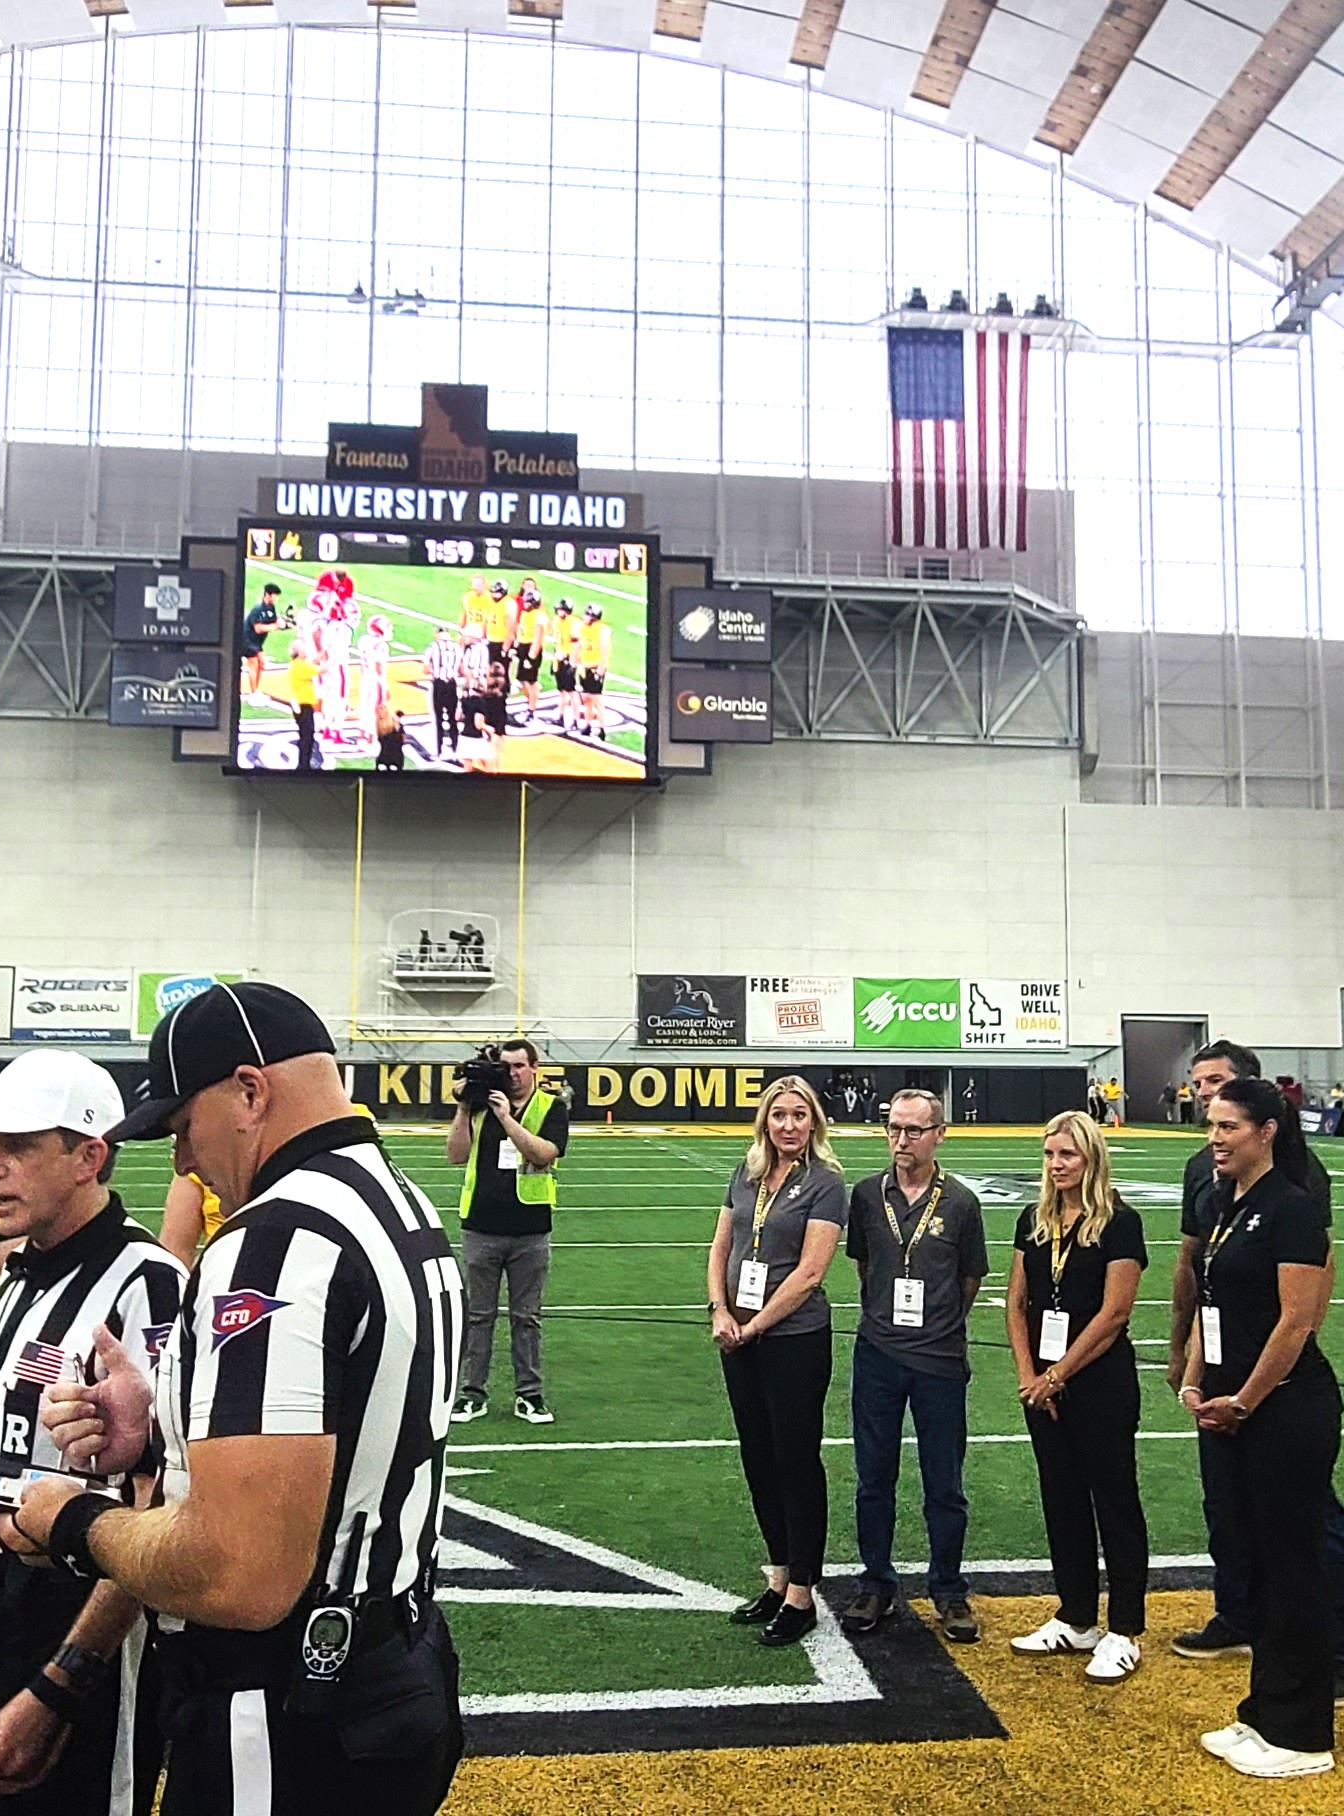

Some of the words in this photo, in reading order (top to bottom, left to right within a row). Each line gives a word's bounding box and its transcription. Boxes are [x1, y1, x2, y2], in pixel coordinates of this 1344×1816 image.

[334, 442, 410, 471] Famous
[492, 449, 577, 477] Potatoes
[276, 481, 470, 523] UNIVERSITY
[478, 493, 519, 524] OF
[529, 494, 627, 529] IDAHO
[425, 539, 475, 565] 1:59
[718, 610, 754, 622] Idaho
[143, 624, 190, 636] IDAHO
[718, 622, 766, 635] Central
[142, 687, 214, 703] INLAND
[704, 695, 767, 713] Glanbia
[19, 979, 128, 993] ROGERS
[750, 978, 790, 993] FREE
[1020, 984, 1061, 997] DRIVE
[60, 1004, 119, 1013] SUBARU
[777, 1003, 819, 1014] PROJECT
[899, 1002, 956, 1022] ICCU
[1021, 1000, 1062, 1017] WELL,
[647, 1015, 705, 1029] Clearwater
[707, 1016, 736, 1030] River
[778, 1014, 820, 1027] FILTER
[1015, 1017, 1061, 1031] IDAHO.
[646, 1037, 737, 1046] www.crcasino.com
[965, 1033, 1006, 1044] SHIFT
[587, 1067, 766, 1108] DOME
[83, 1108, 95, 1125] S
[221, 1309, 250, 1327] CFO
[3, 1416, 30, 1455] R
